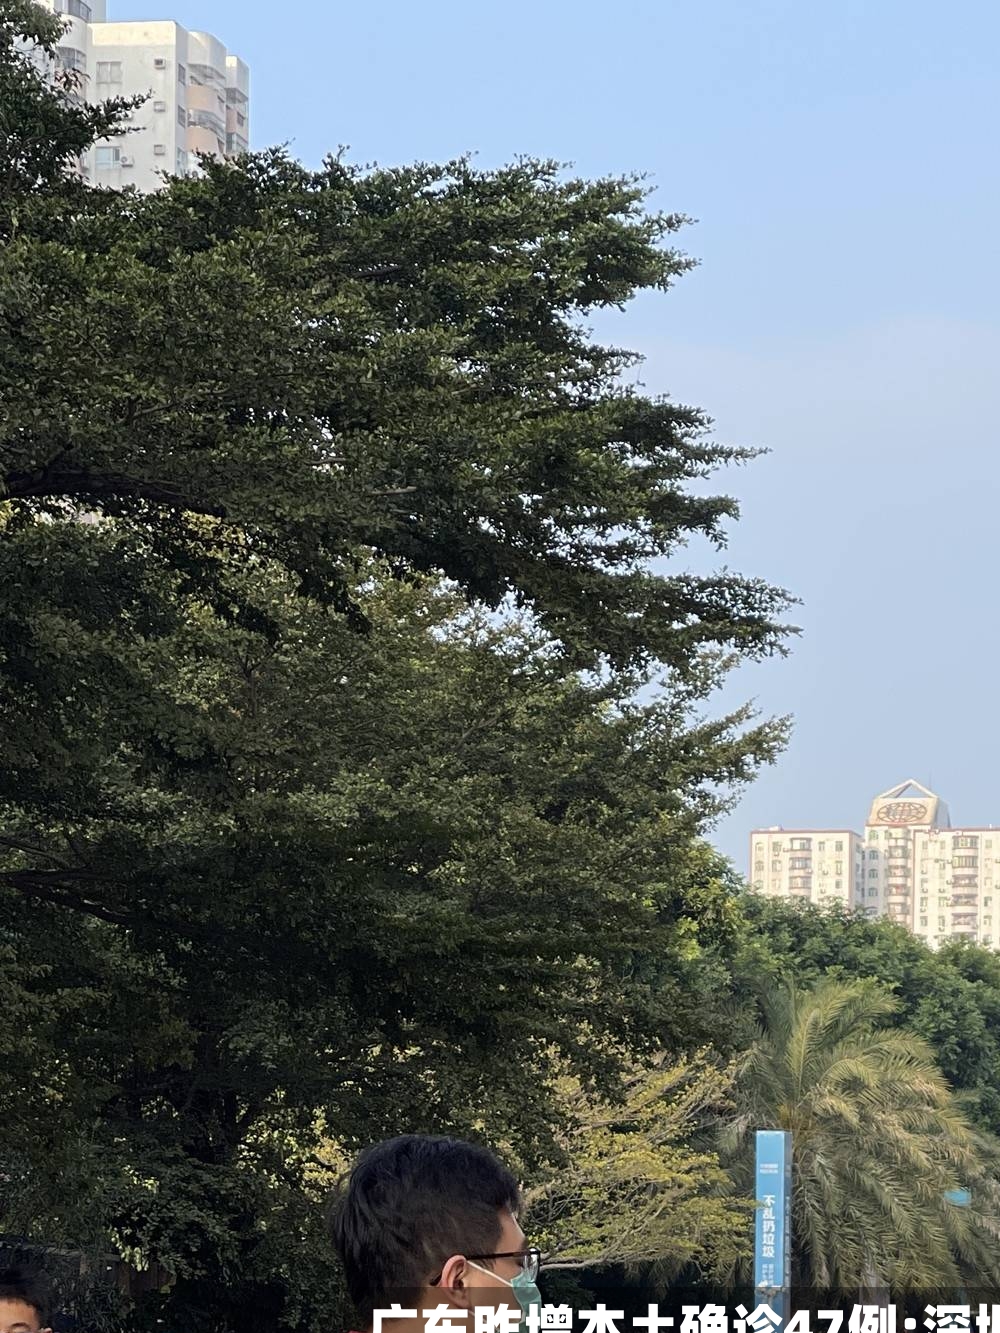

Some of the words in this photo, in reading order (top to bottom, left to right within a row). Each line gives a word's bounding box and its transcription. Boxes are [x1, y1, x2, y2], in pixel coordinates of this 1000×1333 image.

[762, 1195, 776, 1258] 不乱扔垃圾
